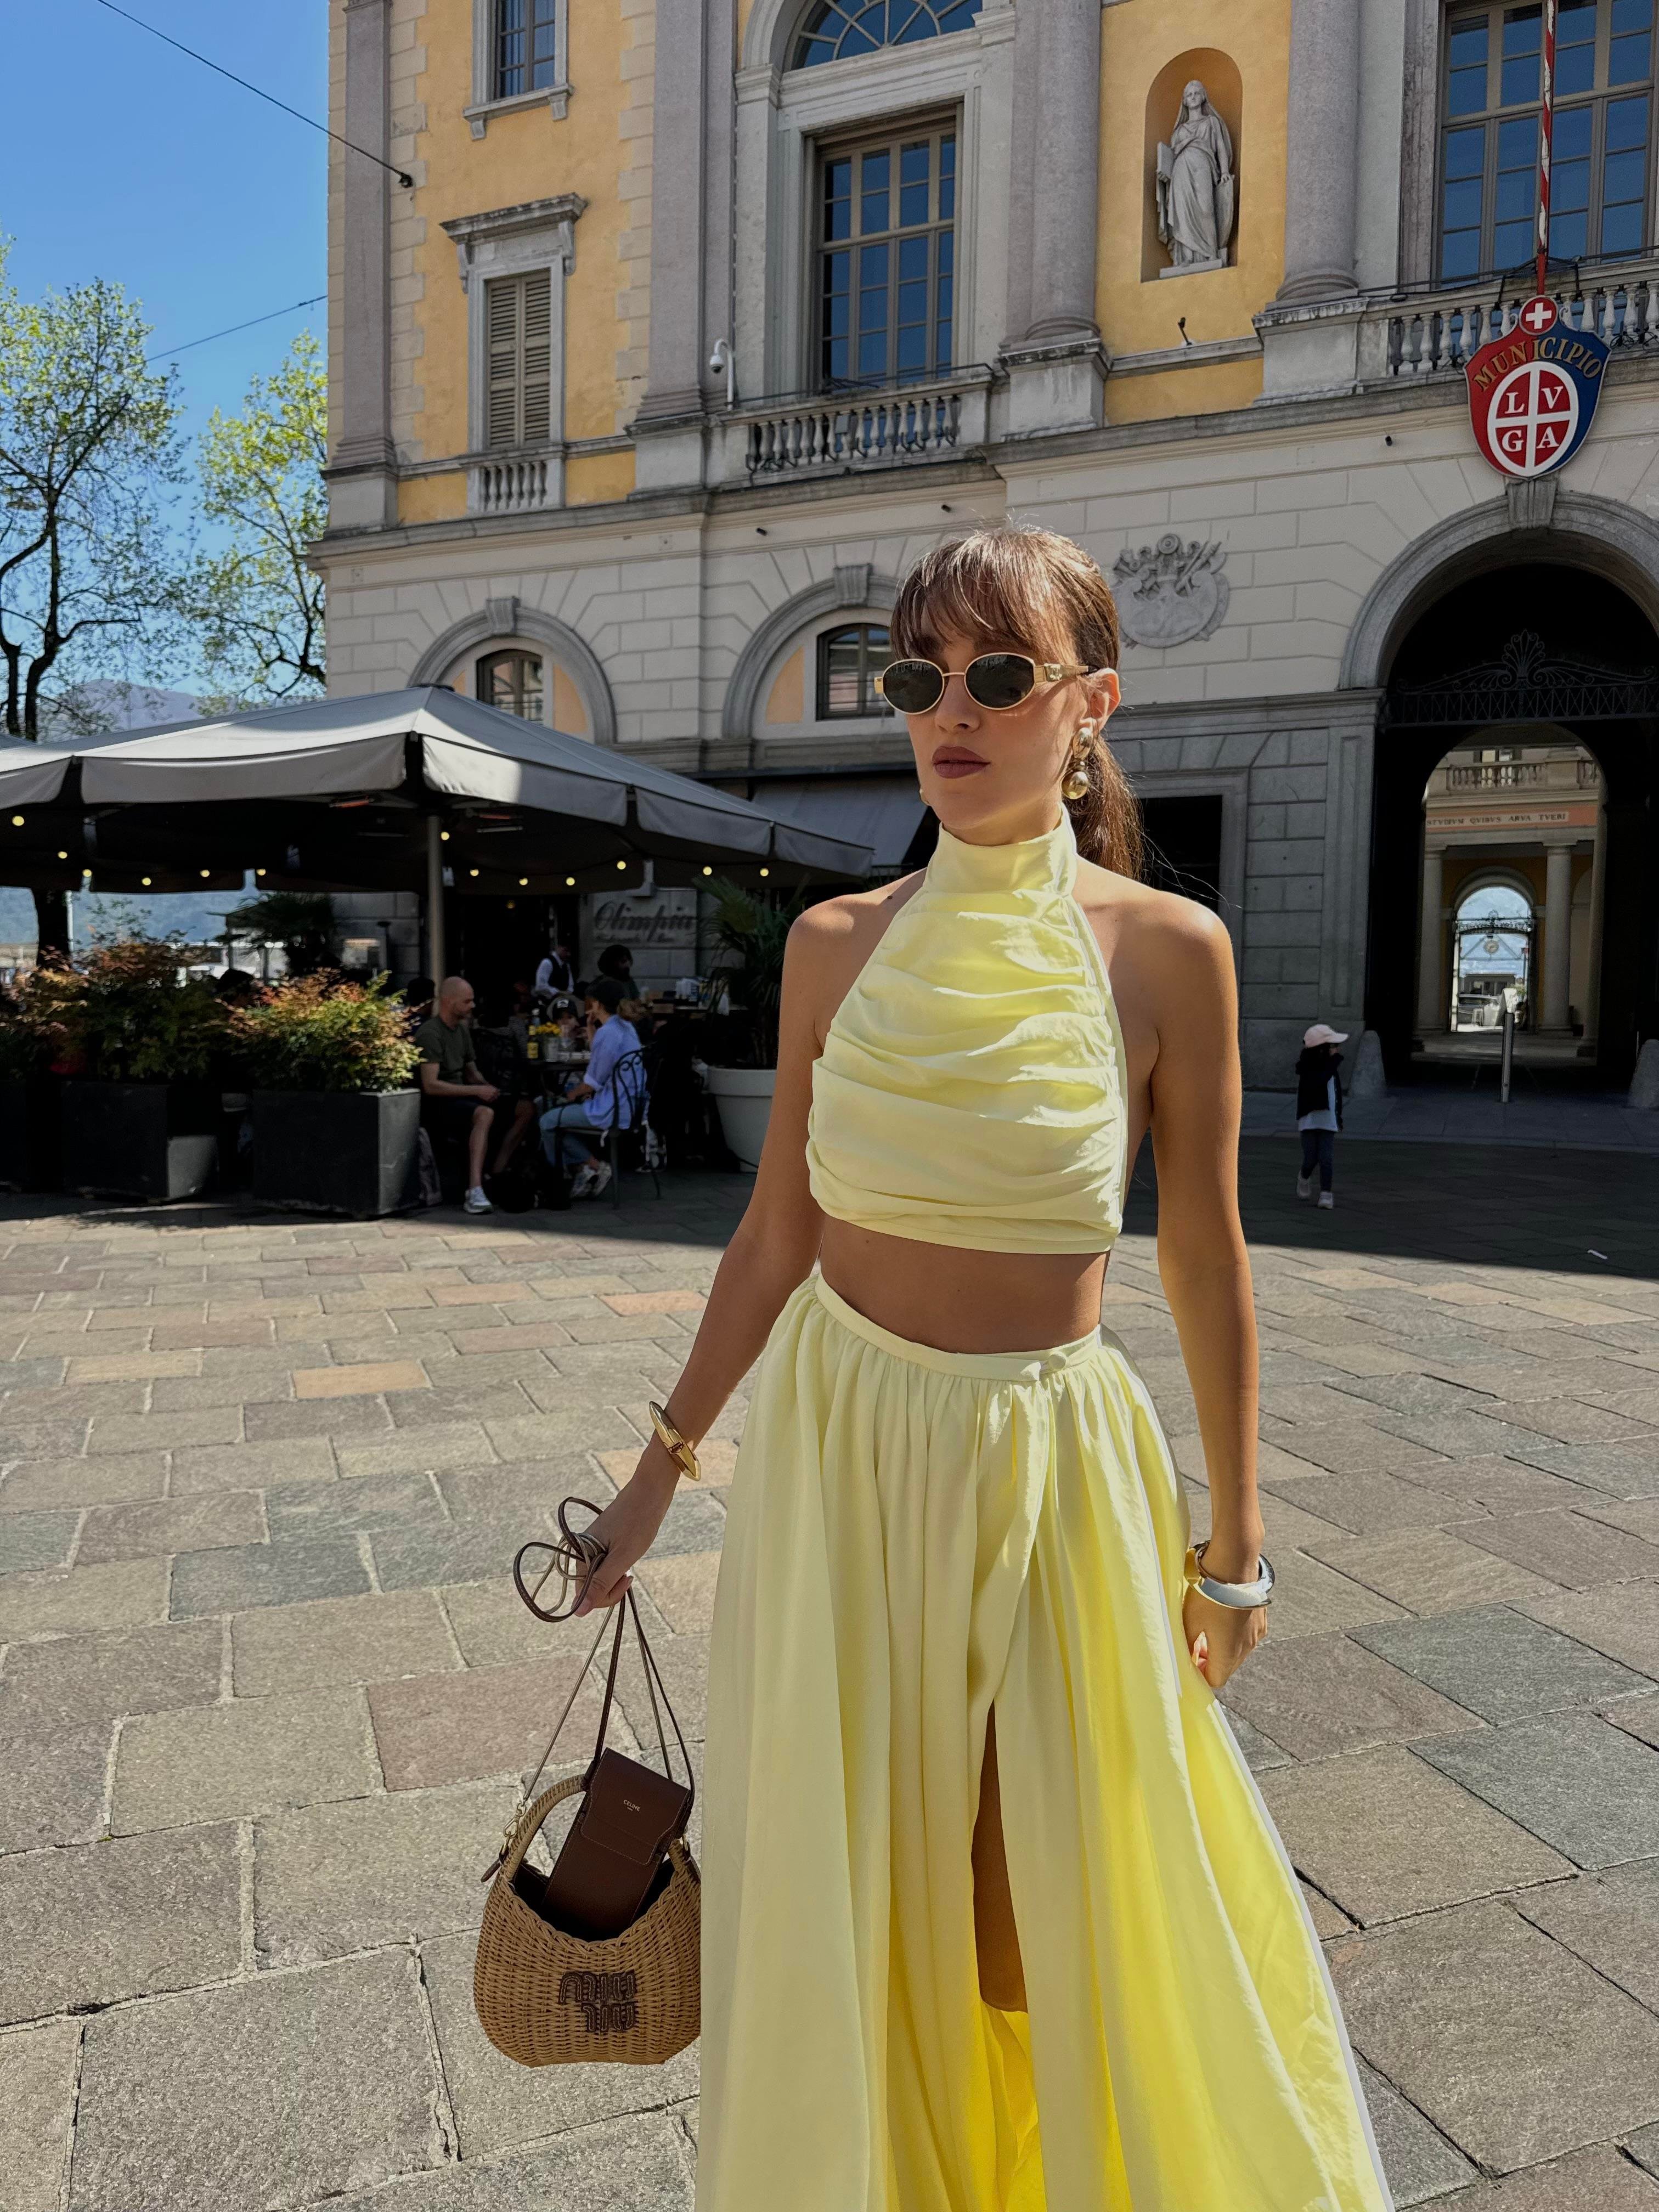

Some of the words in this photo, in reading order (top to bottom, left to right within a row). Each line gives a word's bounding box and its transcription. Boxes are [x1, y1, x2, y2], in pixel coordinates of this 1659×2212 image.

[1472, 336, 1602, 392] MUNICIPIO
[595, 900, 694, 941] Olimpia
[623, 1799, 641, 1812] CELINE
